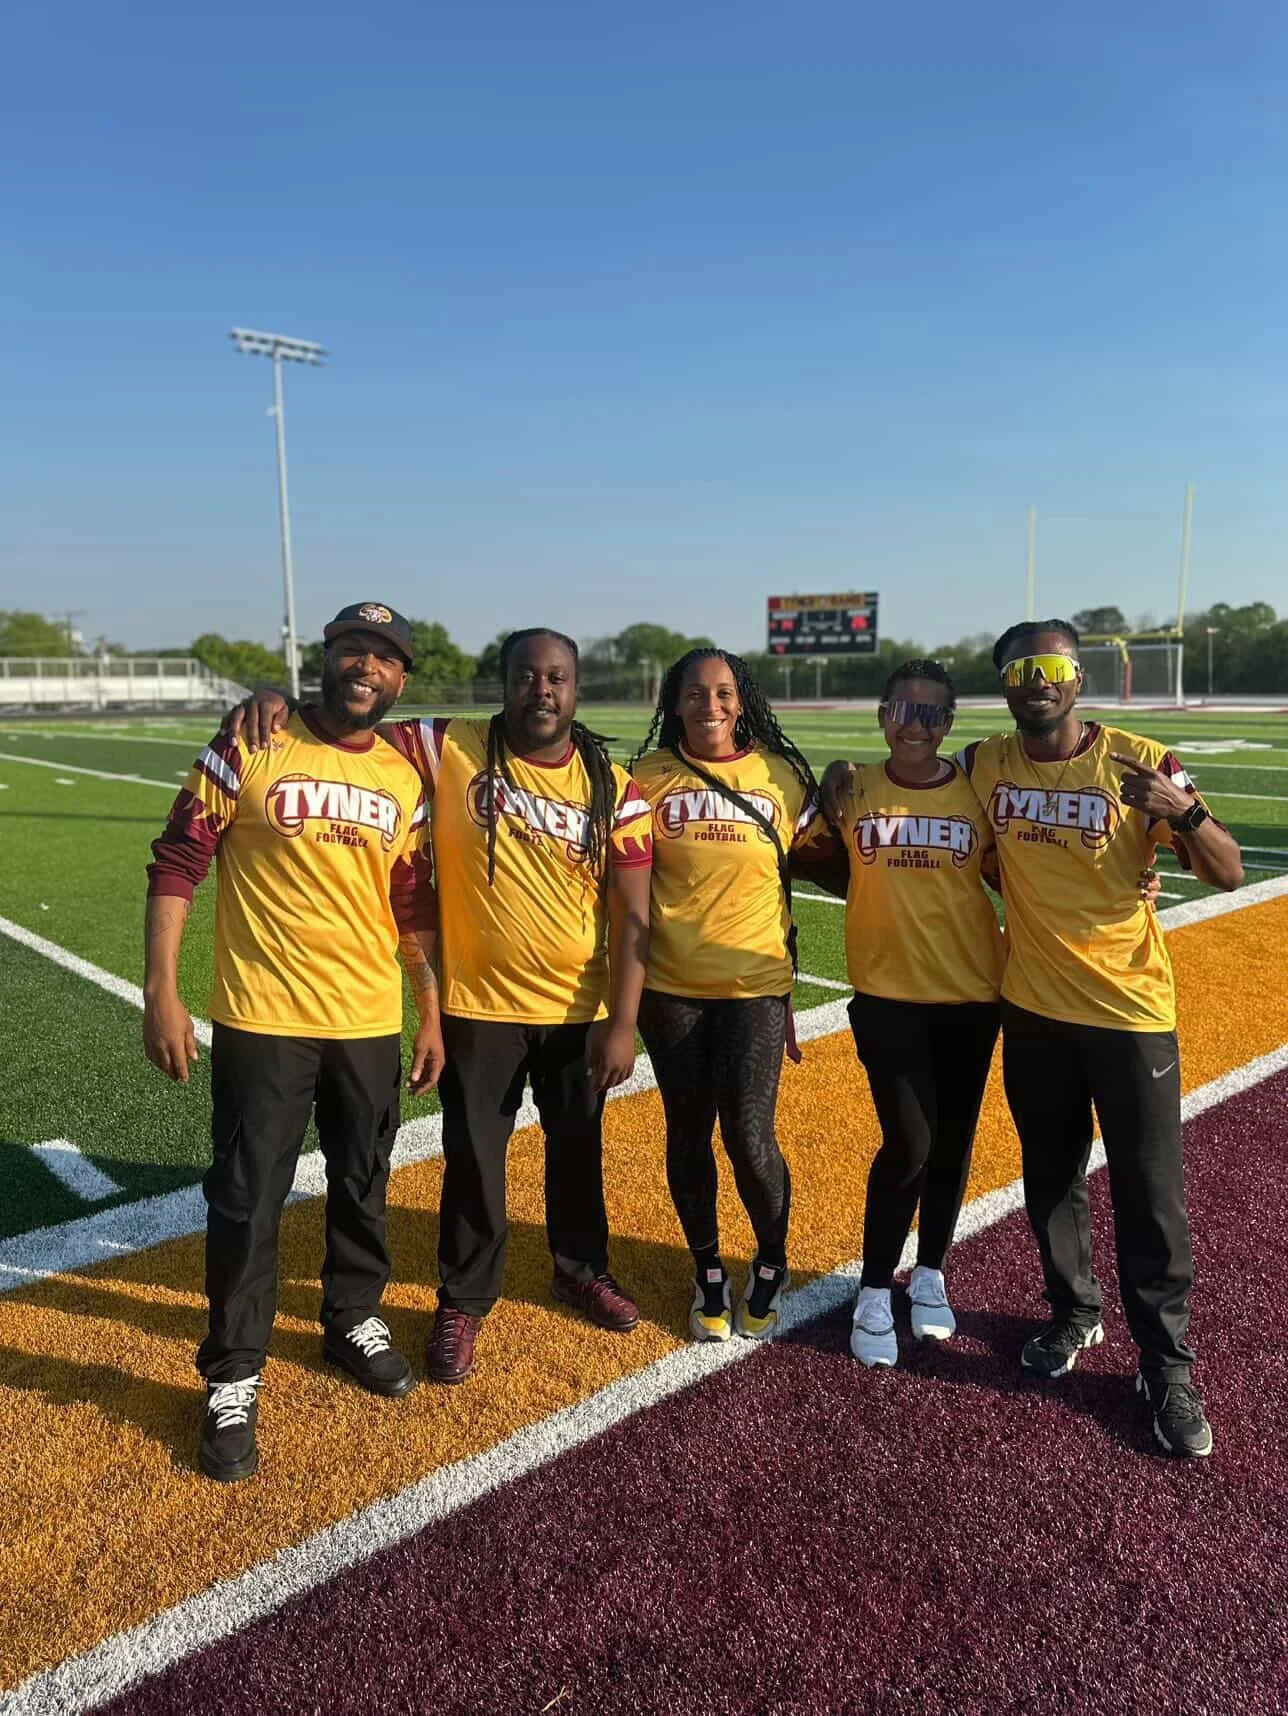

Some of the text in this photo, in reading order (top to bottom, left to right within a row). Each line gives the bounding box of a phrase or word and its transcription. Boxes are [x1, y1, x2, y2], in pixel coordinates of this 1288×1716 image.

[275, 781, 398, 837] TYNER
[995, 785, 1108, 833] TYNER
[329, 823, 358, 836] FLAG
[708, 823, 735, 832] FLAG
[316, 832, 369, 848] FOOTBALL
[694, 831, 747, 842] FOOTBALL
[859, 816, 971, 855] TYNER
[901, 849, 929, 859] FLAG
[887, 858, 941, 869] FOOTBALL
